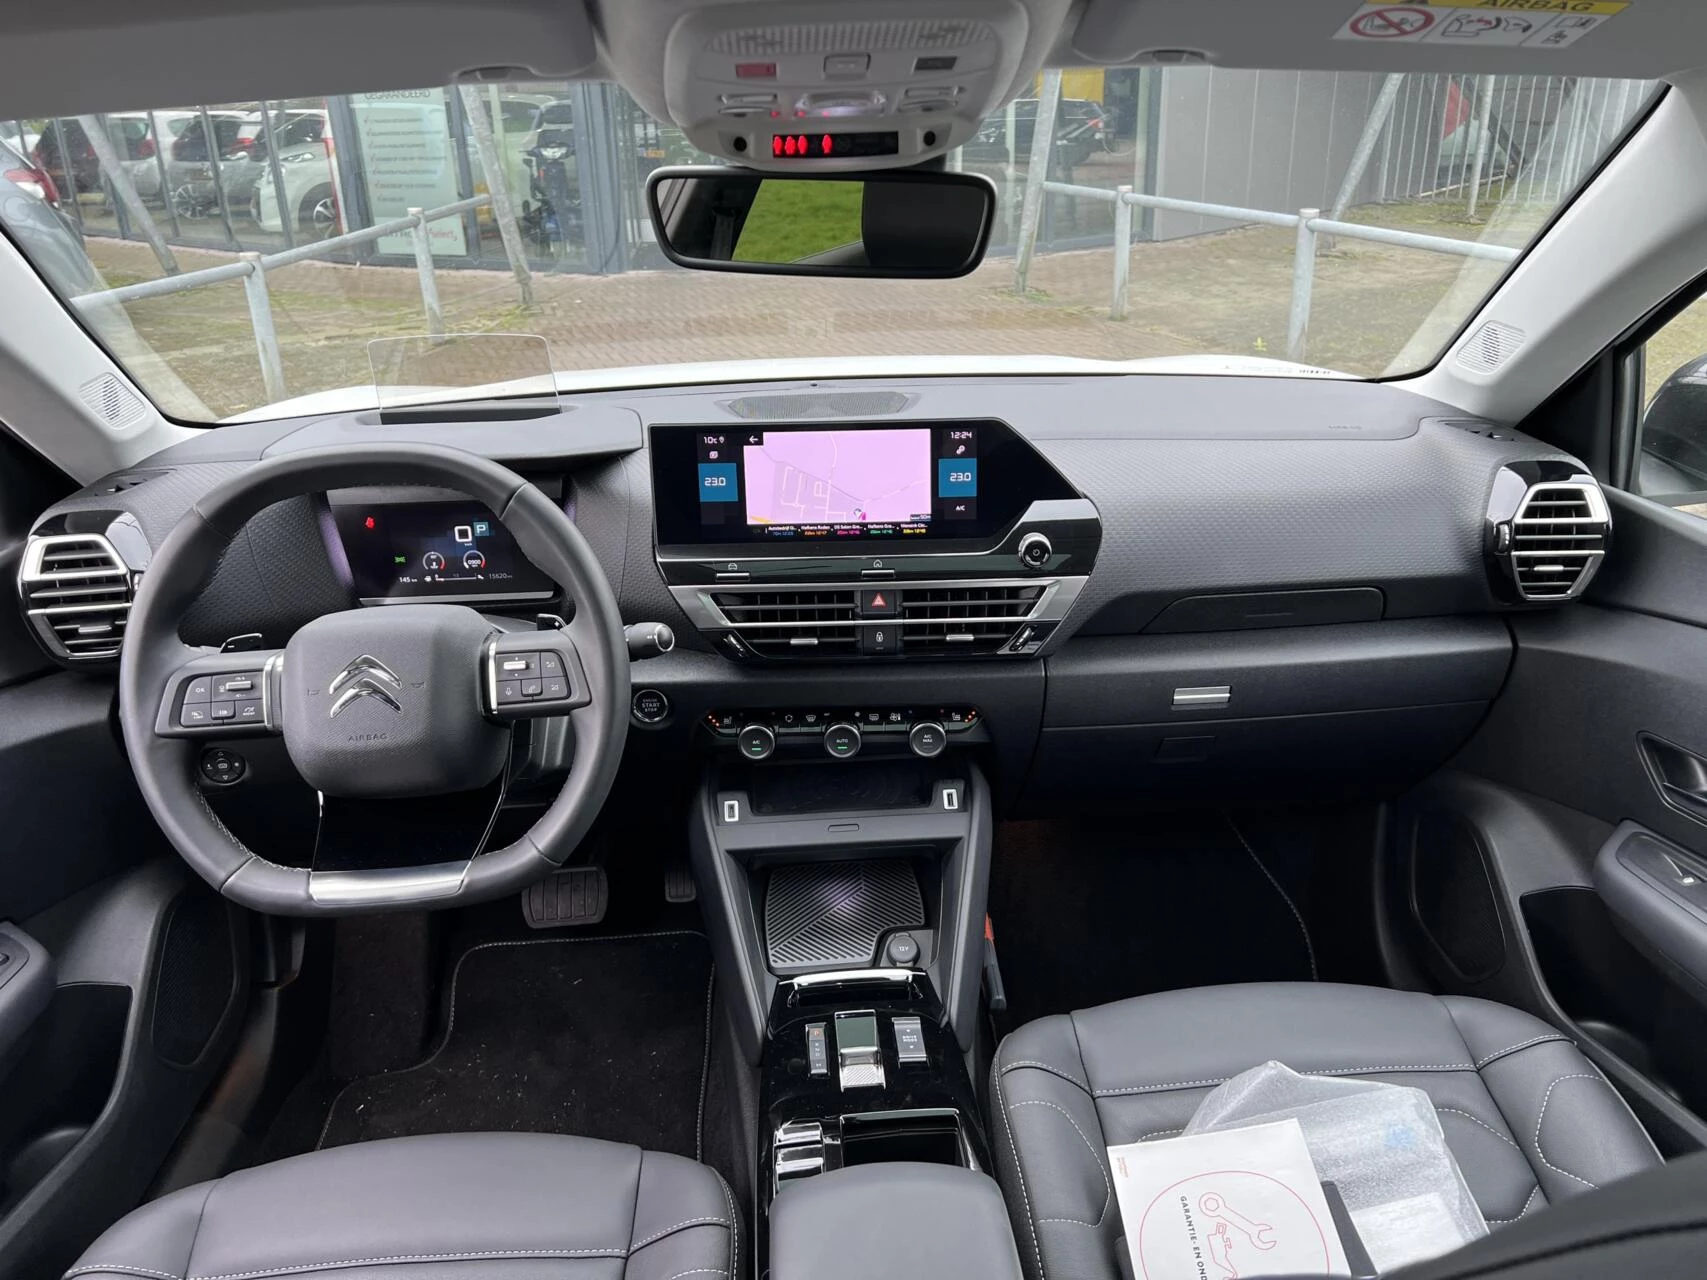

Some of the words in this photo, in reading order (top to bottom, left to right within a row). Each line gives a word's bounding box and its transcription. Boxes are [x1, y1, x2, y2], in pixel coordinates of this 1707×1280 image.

[1477, 0, 1594, 12] AIRBAG
[950, 431, 972, 439] 12:24
[476, 524, 487, 534] P
[1193, 1246, 1202, 1259] EN
